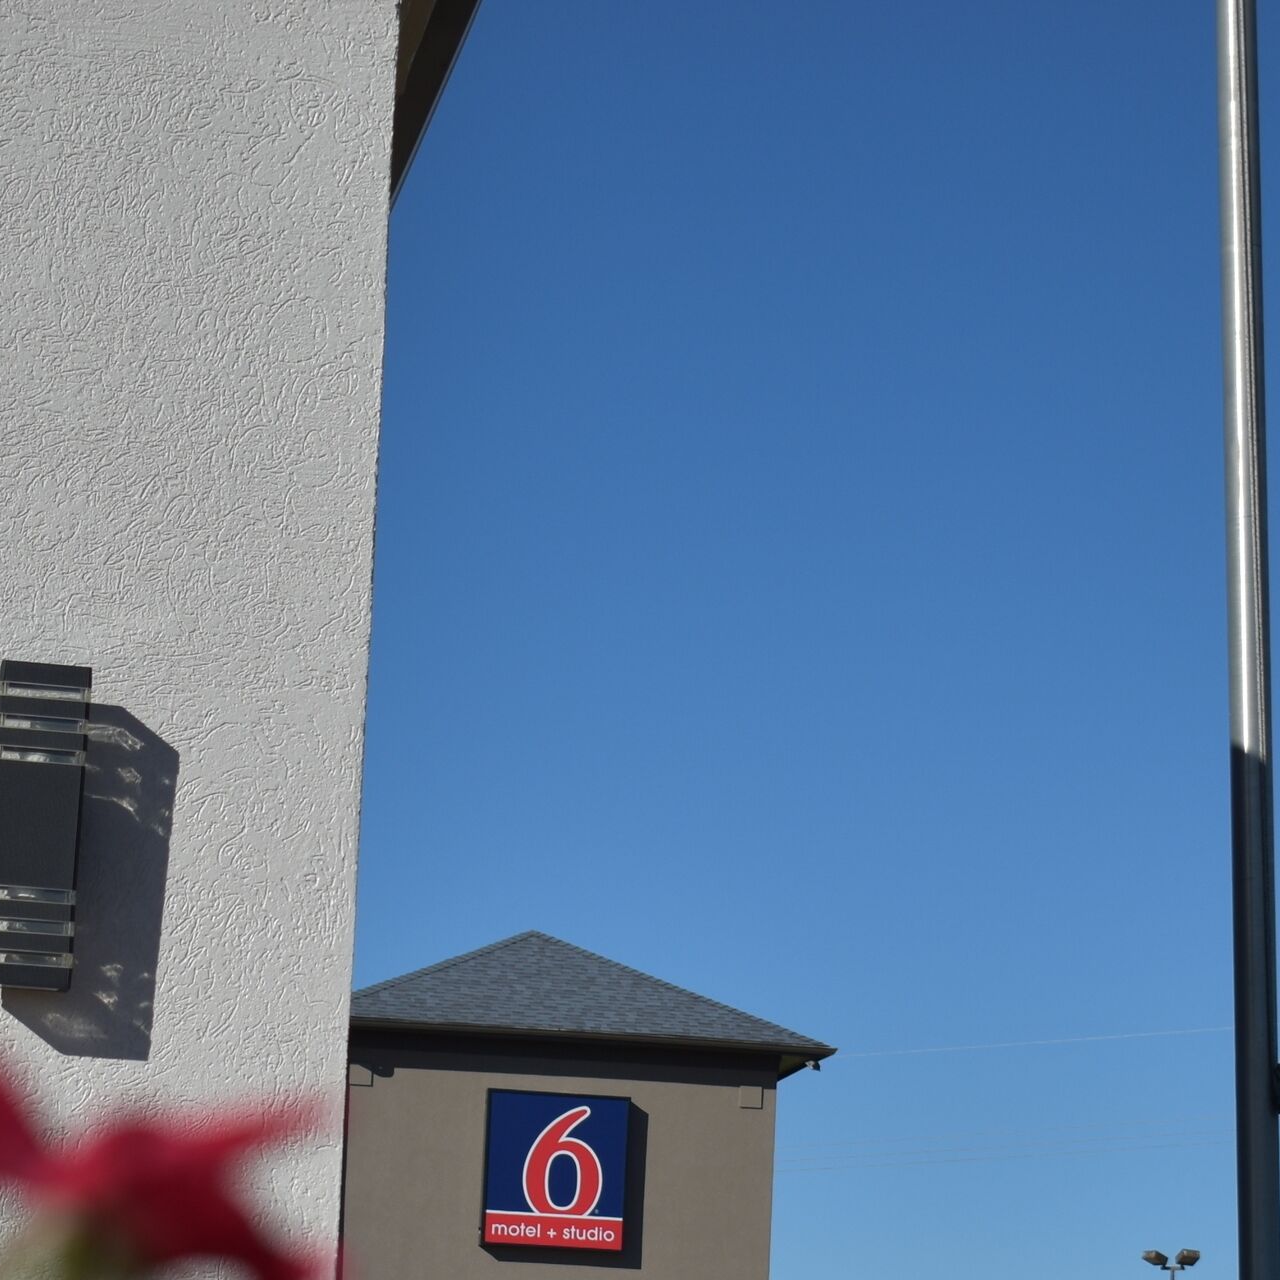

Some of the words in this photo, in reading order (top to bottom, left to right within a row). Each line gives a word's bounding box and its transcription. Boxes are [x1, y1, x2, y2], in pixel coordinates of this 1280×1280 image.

[523, 1106, 602, 1216] 6
[491, 1222, 541, 1238] motel
[562, 1225, 615, 1242] studio
